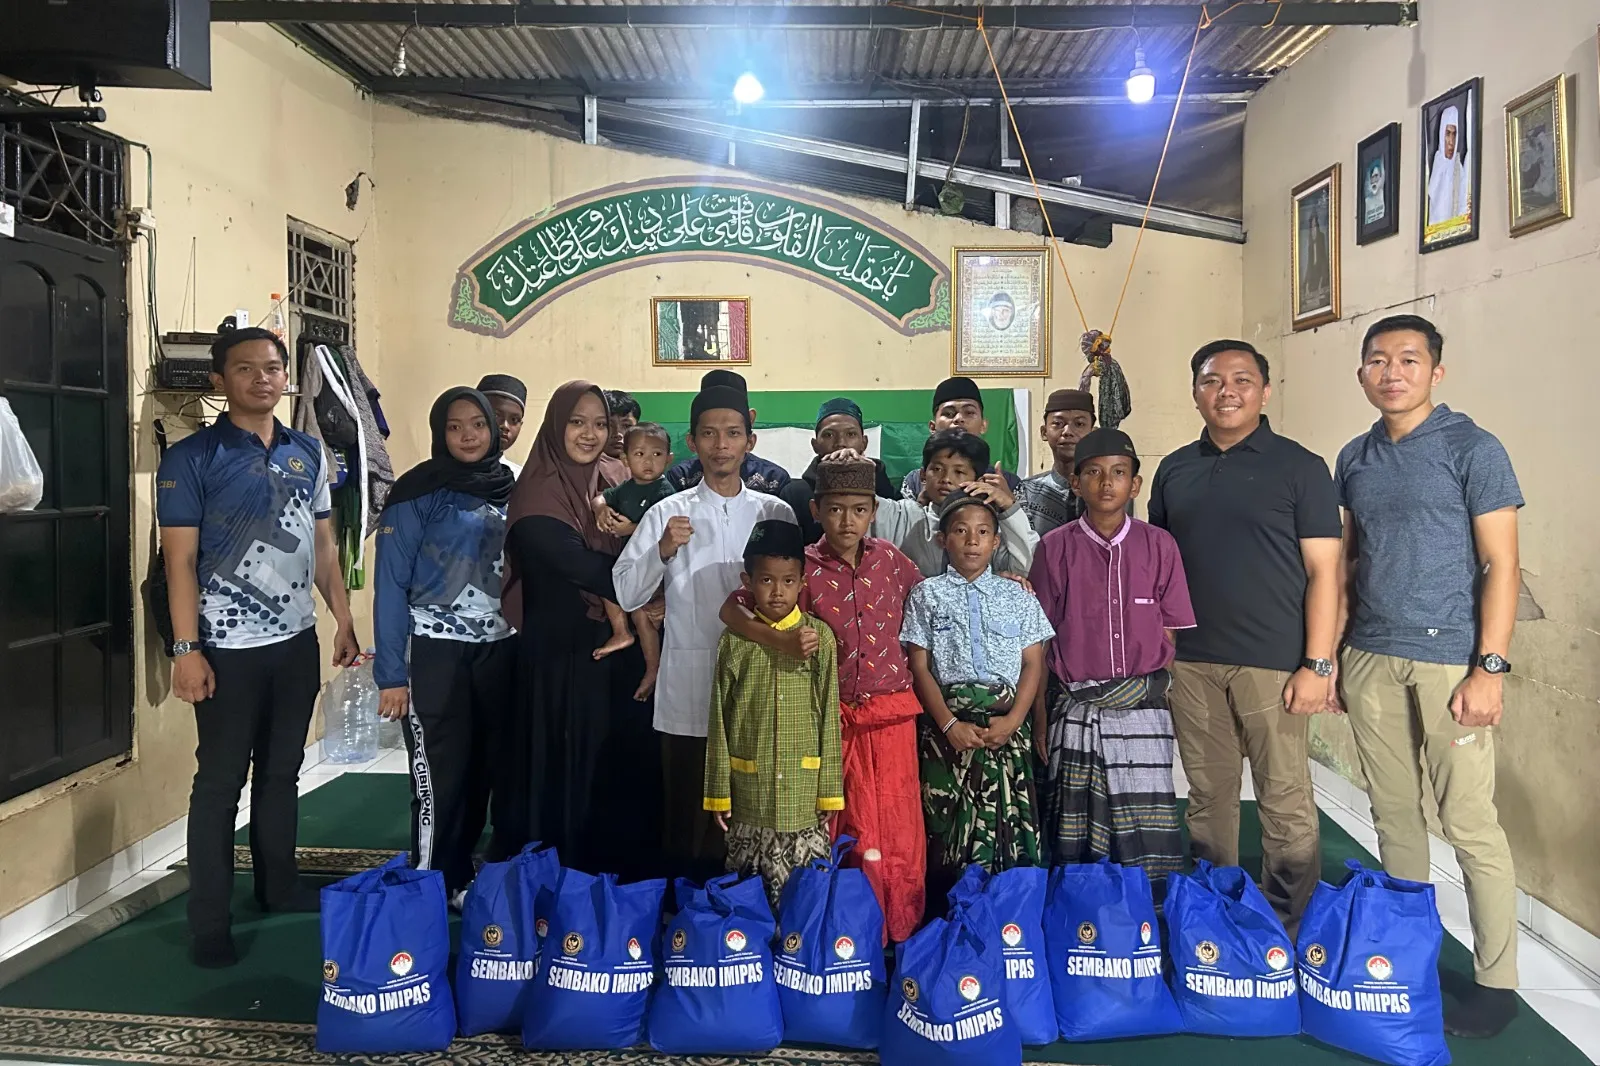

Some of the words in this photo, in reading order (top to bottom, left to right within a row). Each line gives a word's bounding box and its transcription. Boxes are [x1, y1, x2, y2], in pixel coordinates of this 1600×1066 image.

[415, 762, 431, 826] CIBINONG
[470, 957, 534, 981] SEMBAKO
[547, 965, 611, 994] SEMBAKO
[611, 971, 654, 994] IMIPAS
[718, 961, 763, 987] IMIPAS
[1005, 958, 1035, 980] IPAS
[1067, 955, 1132, 979] SEMBAKO
[1133, 955, 1162, 978] IMIP
[825, 969, 872, 994] IMIPAS
[1185, 972, 1254, 998] SEMBAKO
[378, 981, 431, 1012] IMIPAS
[1354, 991, 1411, 1013] IMIPAS
[955, 1006, 1003, 1041] IMIPAS
